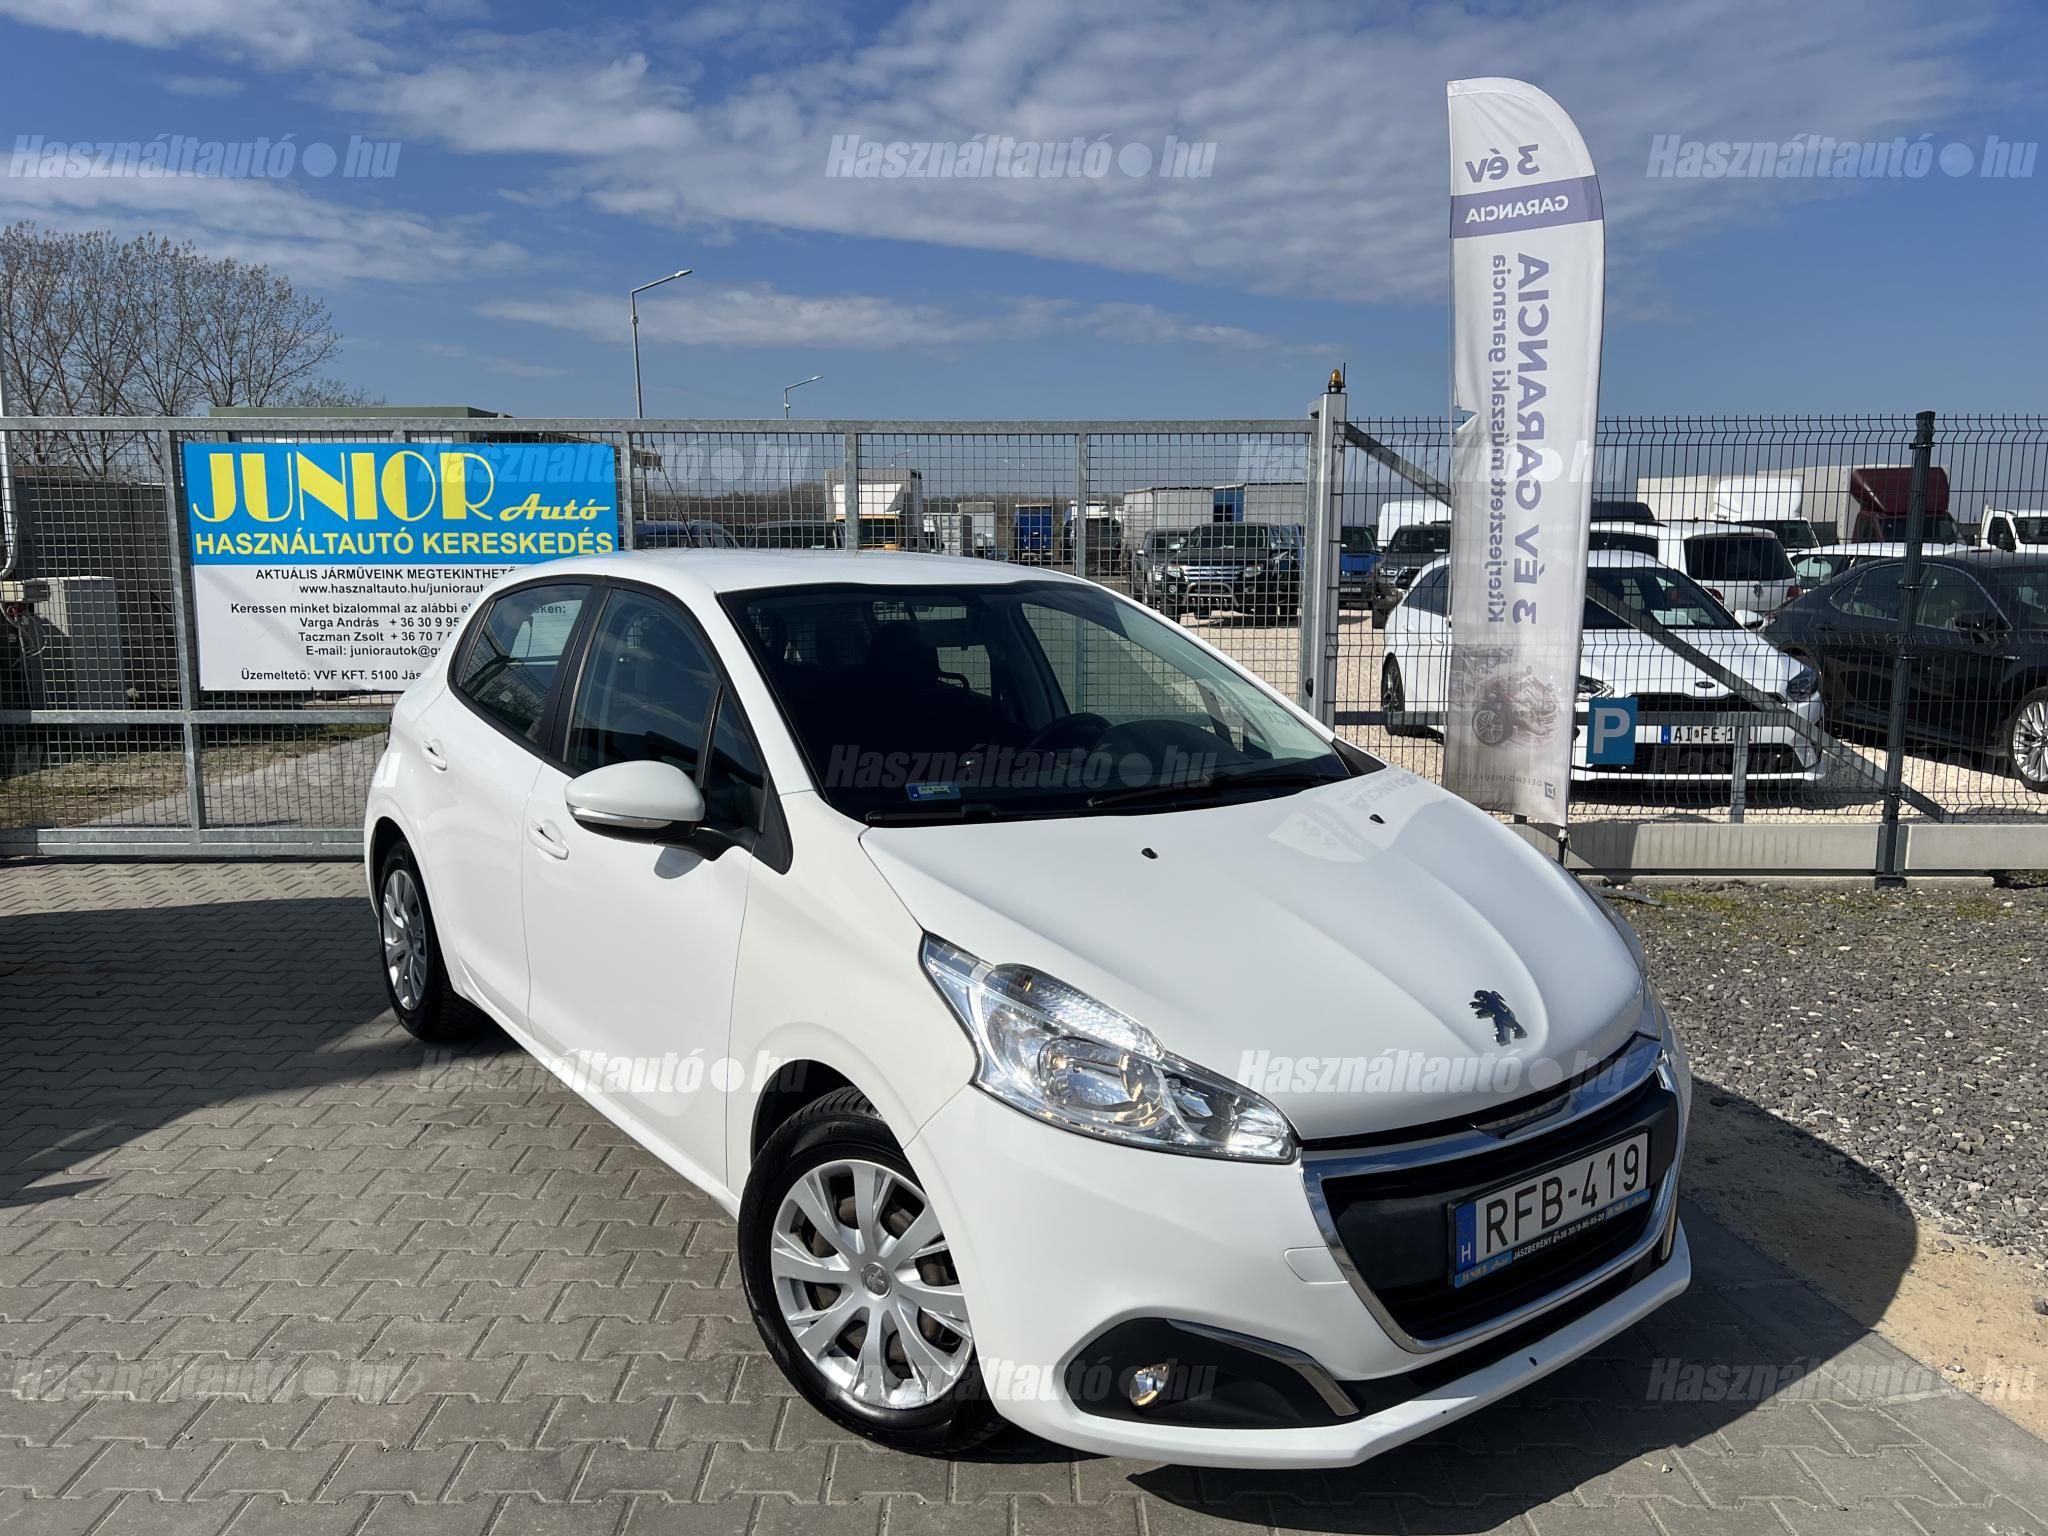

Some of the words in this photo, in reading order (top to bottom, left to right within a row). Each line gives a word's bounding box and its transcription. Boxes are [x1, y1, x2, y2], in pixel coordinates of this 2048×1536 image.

[192, 450, 494, 522] JUNIOR
[500, 494, 610, 521] Autó
[196, 527, 414, 554] HASZNÁLTAUTÓ
[423, 526, 613, 555] KERESKEDÉS
[256, 567, 317, 579] AKTUÁLIS
[321, 566, 403, 579] JÁRMŰVEINK
[299, 584, 487, 596] www.hasznaltauto.hu/junioraut
[231, 604, 286, 613] Keressen
[290, 603, 329, 613] minket
[333, 603, 400, 613] bizalommal
[421, 603, 457, 613] alábbi
[300, 618, 333, 629] Varga
[337, 618, 379, 627] András
[401, 618, 415, 627] 36
[418, 618, 431, 627] 30
[435, 618, 442, 627] 9
[298, 632, 350, 641] Taczman
[354, 632, 384, 641] Zsolt
[402, 632, 415, 641] 36
[419, 632, 433, 641] 70
[306, 646, 347, 655] E-mail:
[350, 646, 441, 657] juniorautok@g
[241, 667, 310, 680] Üzemeltető:
[314, 670, 337, 680] VVF
[341, 670, 367, 680] KFT.
[371, 670, 398, 680] 5100
[1593, 708, 1630, 754] P
[1486, 1143, 1640, 1254] RFB-419
[1461, 1242, 1471, 1264] H
